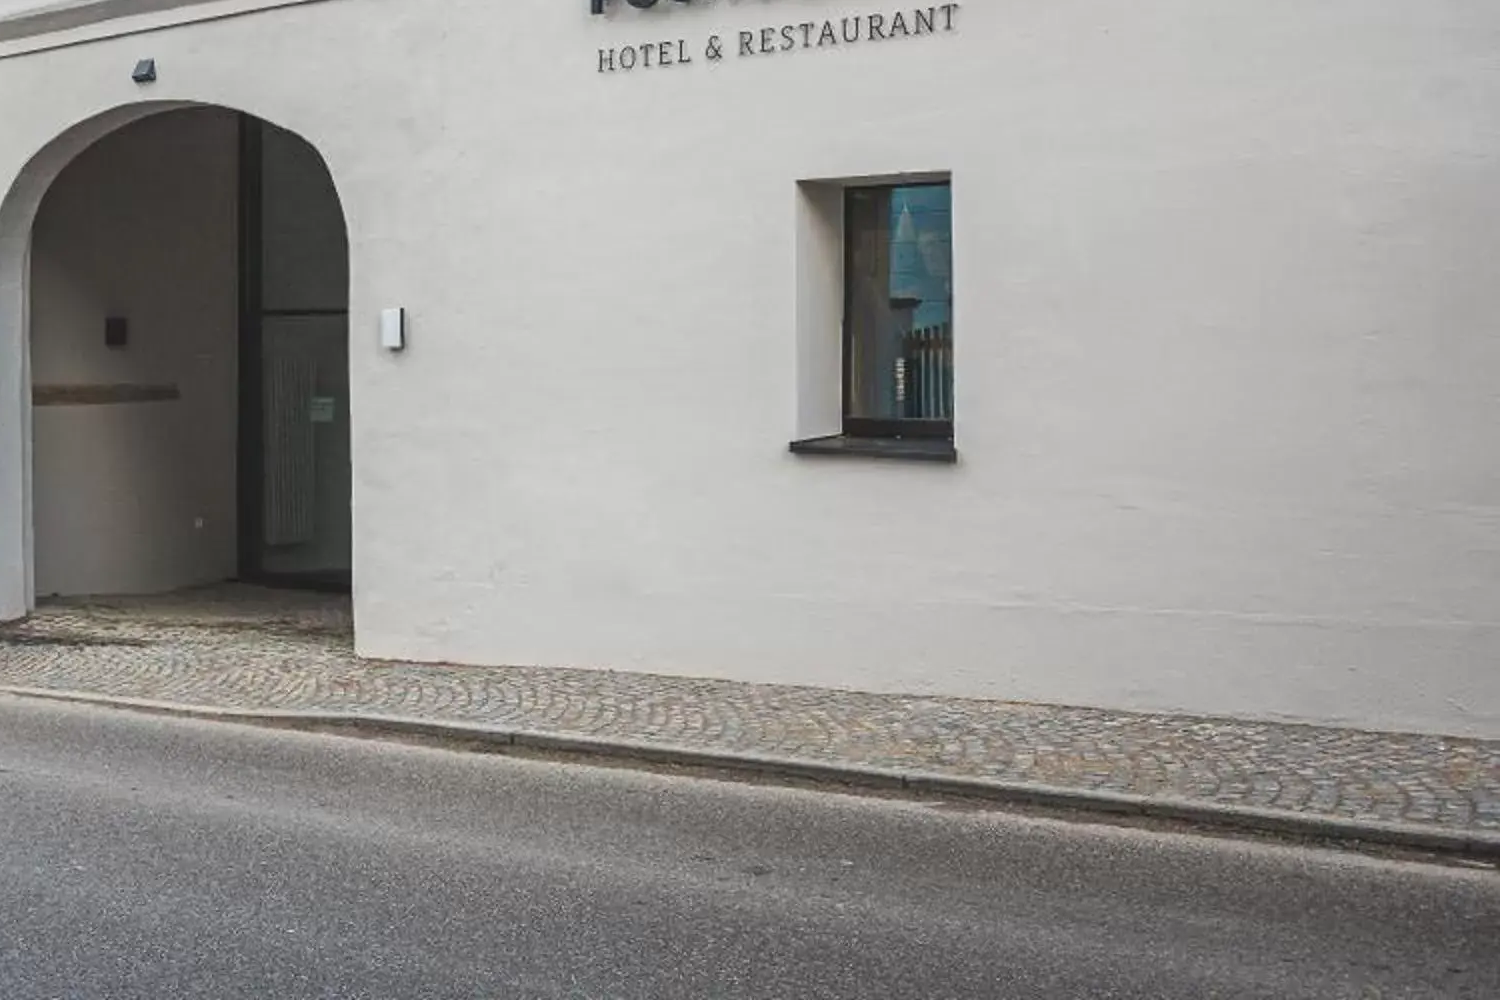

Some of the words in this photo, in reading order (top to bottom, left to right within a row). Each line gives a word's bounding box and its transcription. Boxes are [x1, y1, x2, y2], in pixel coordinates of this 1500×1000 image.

[598, 39, 692, 73] HOTEL
[705, 35, 724, 60] &
[738, 3, 961, 57] RESTAURANT
